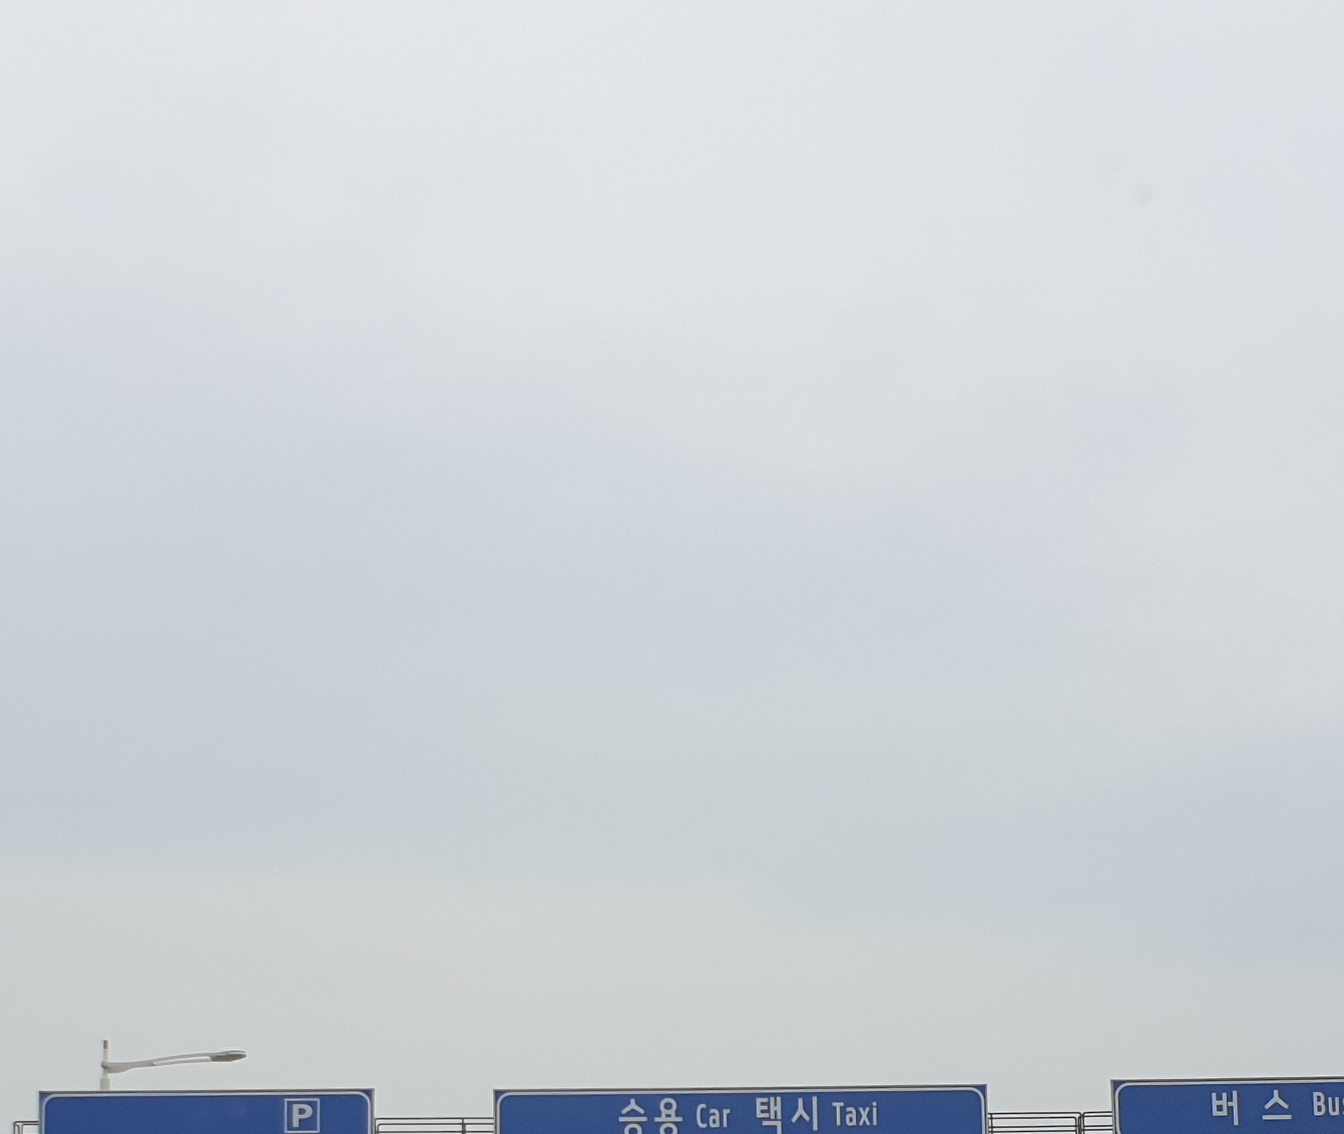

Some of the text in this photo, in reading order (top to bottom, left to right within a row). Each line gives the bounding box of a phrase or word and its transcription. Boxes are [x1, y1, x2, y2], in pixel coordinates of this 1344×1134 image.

[695, 1103, 730, 1129] Car
[832, 1101, 878, 1127] Taxi
[1211, 1090, 1292, 1126] 버스
